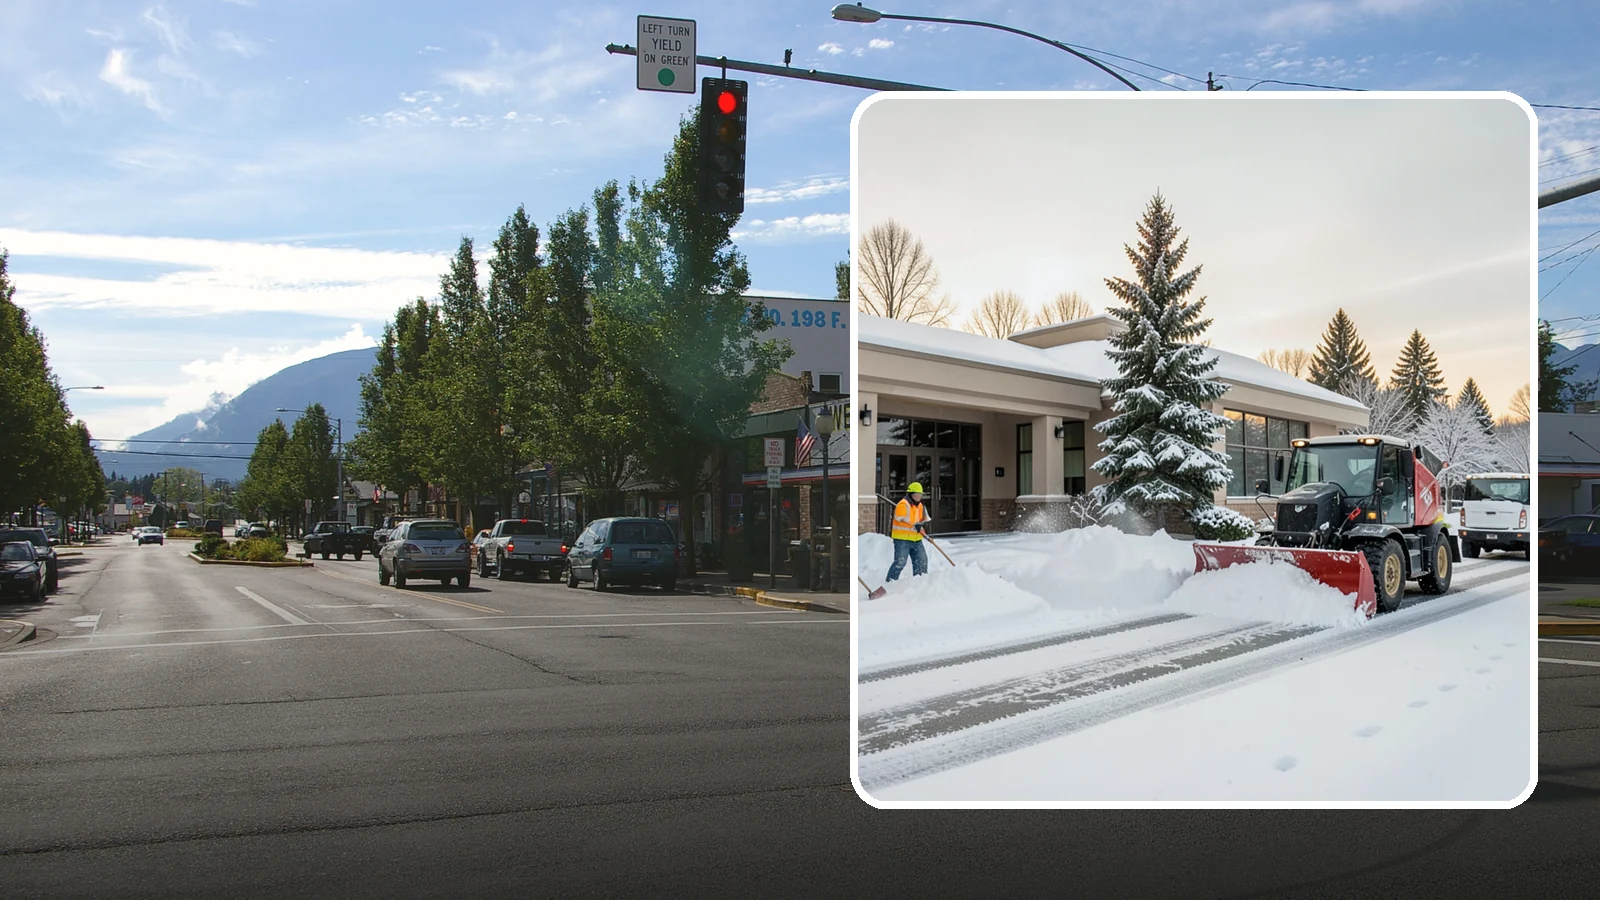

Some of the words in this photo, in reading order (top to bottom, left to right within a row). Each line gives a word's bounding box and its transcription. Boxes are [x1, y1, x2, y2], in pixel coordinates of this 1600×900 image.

[643, 23, 663, 34] LEFT
[668, 25, 690, 36] TURN
[652, 38, 682, 51] YIELD
[644, 53, 656, 64] ON
[661, 54, 689, 66] GREEN
[791, 309, 826, 328] 198
[831, 311, 847, 329] F.
